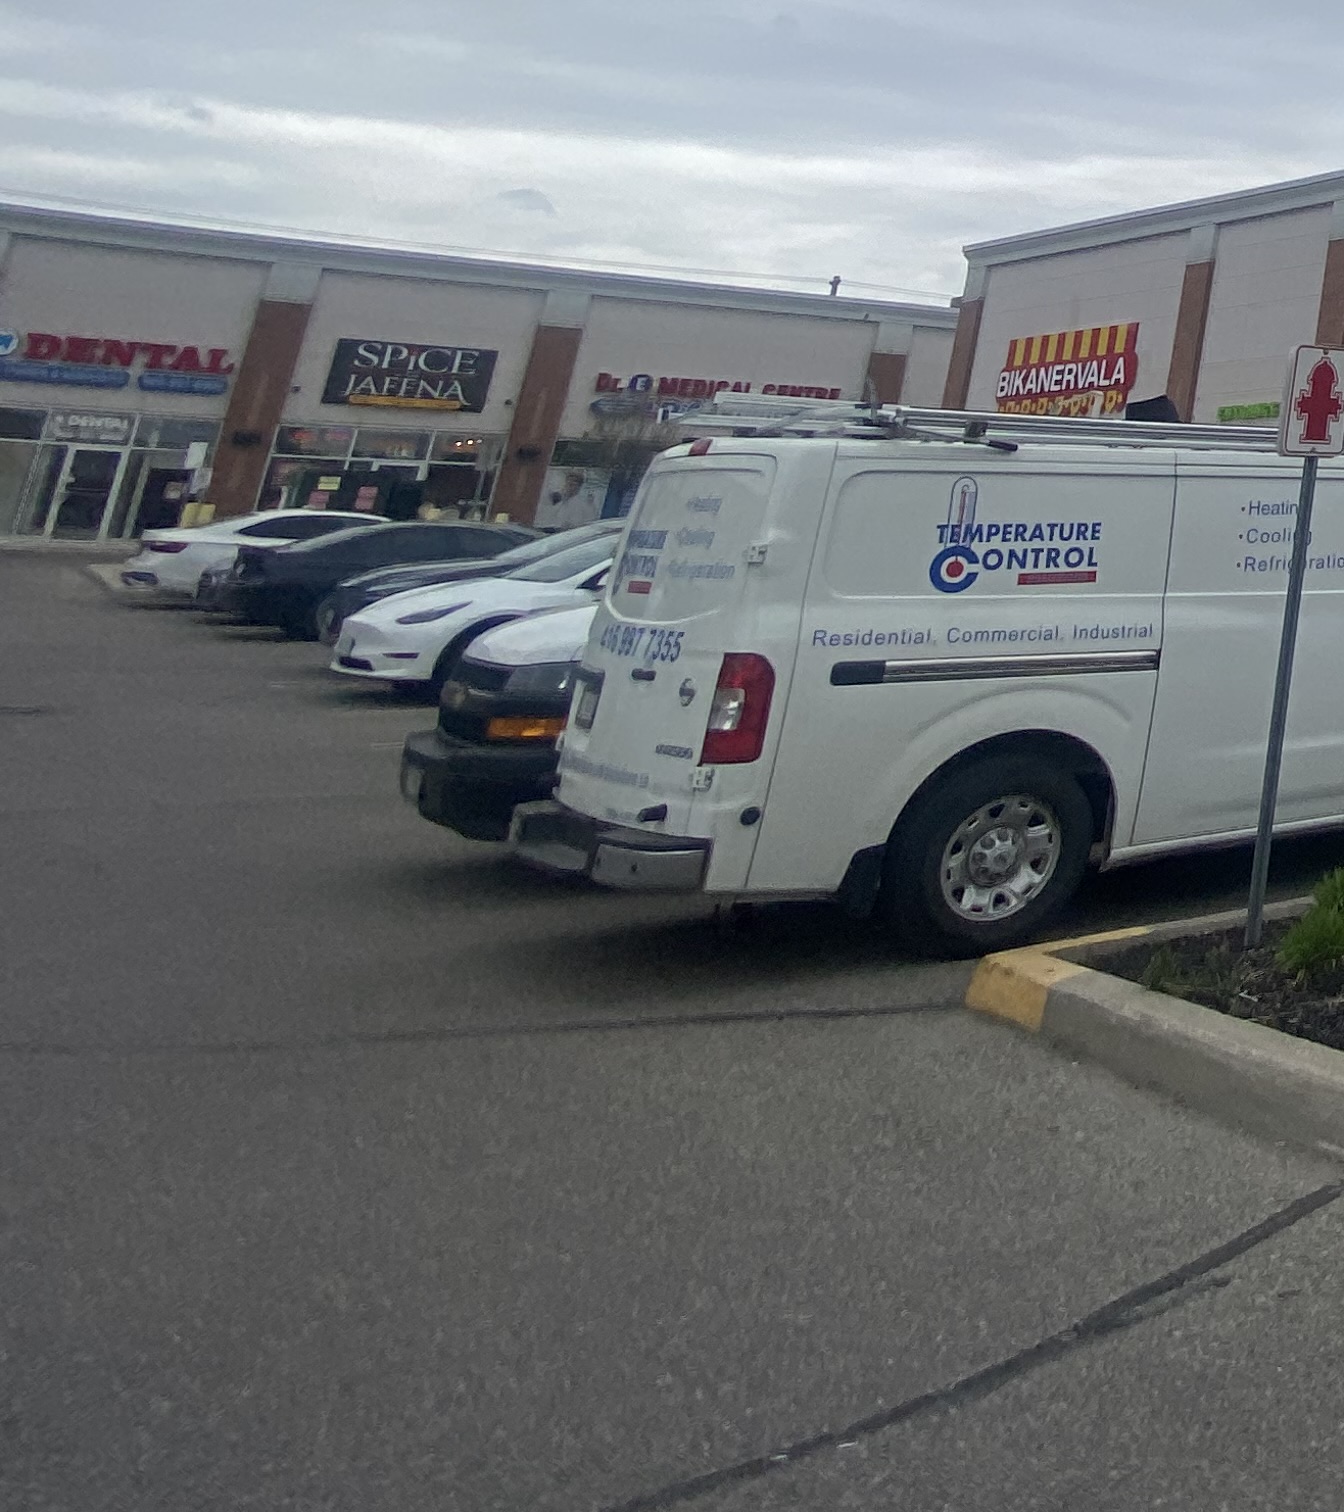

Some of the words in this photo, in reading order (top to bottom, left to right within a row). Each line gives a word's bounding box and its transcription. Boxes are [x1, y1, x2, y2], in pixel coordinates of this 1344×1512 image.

[24, 332, 234, 374] DENTAL
[343, 374, 472, 406] JAFFNA
[996, 356, 1125, 398] BIKANERVALA
[1248, 500, 1299, 516] Heatin
[936, 522, 1102, 544] TEMPERATURE
[1246, 528, 1312, 546] Coolig
[1073, 622, 1154, 639] Industrial
[644, 629, 685, 662] 7355
